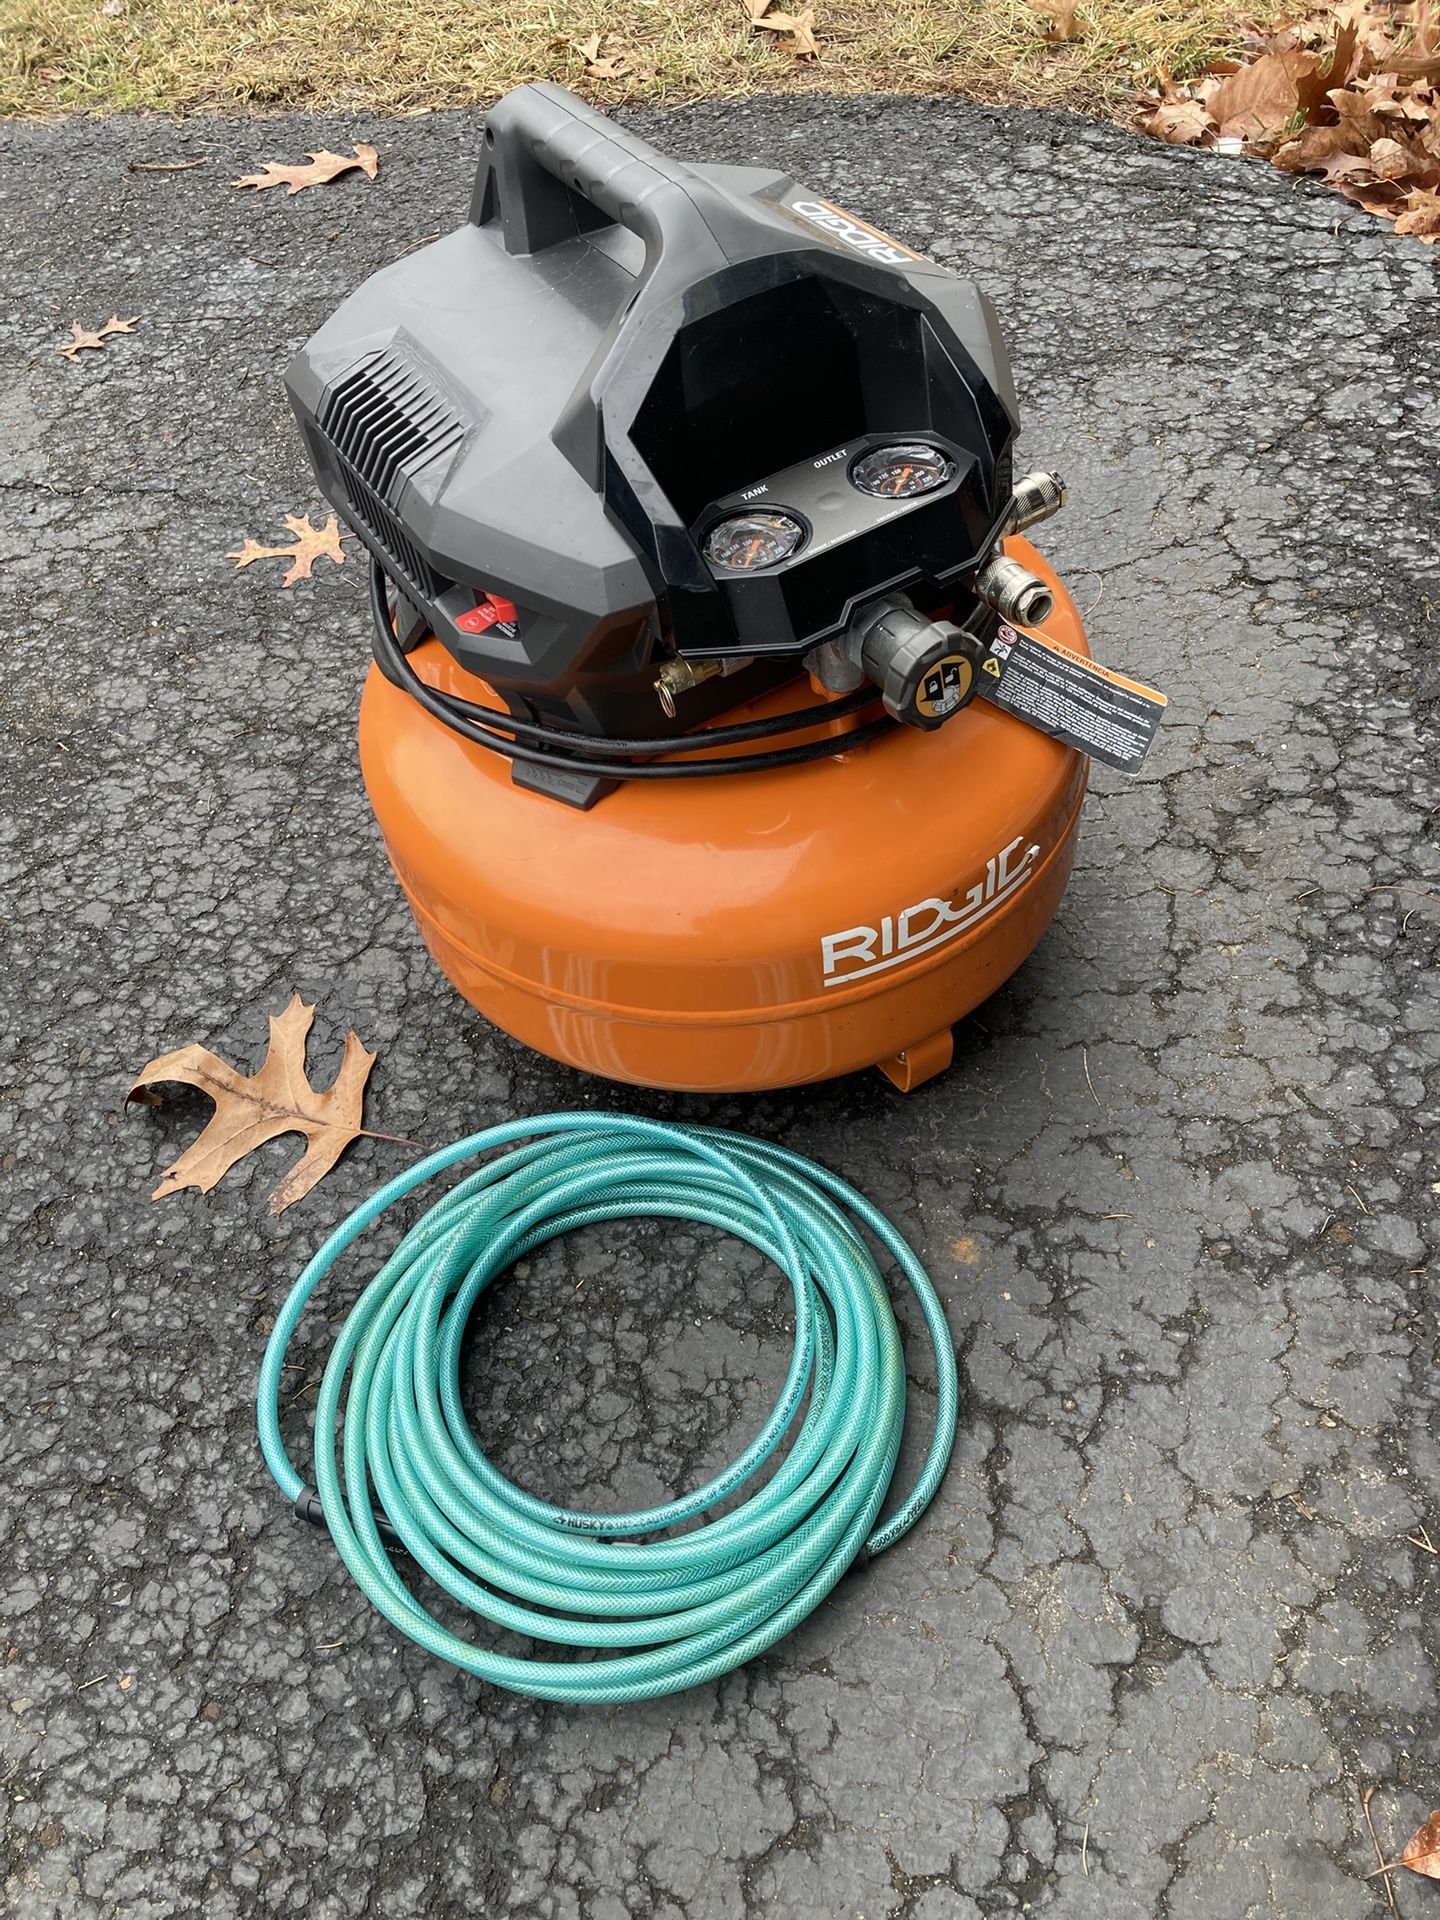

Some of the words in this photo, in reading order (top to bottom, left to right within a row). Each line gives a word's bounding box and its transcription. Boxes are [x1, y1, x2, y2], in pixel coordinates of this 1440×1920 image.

[792, 201, 914, 264] RIDGID
[813, 449, 848, 469] OUTLET
[741, 484, 769, 500] TANK
[1060, 649, 1110, 678] ADVERTENCIA
[719, 1458, 755, 1492] BURSTING
[767, 1423, 782, 1440] NOT
[779, 1406, 791, 1422] USE
[789, 1375, 804, 1405] ABOVE
